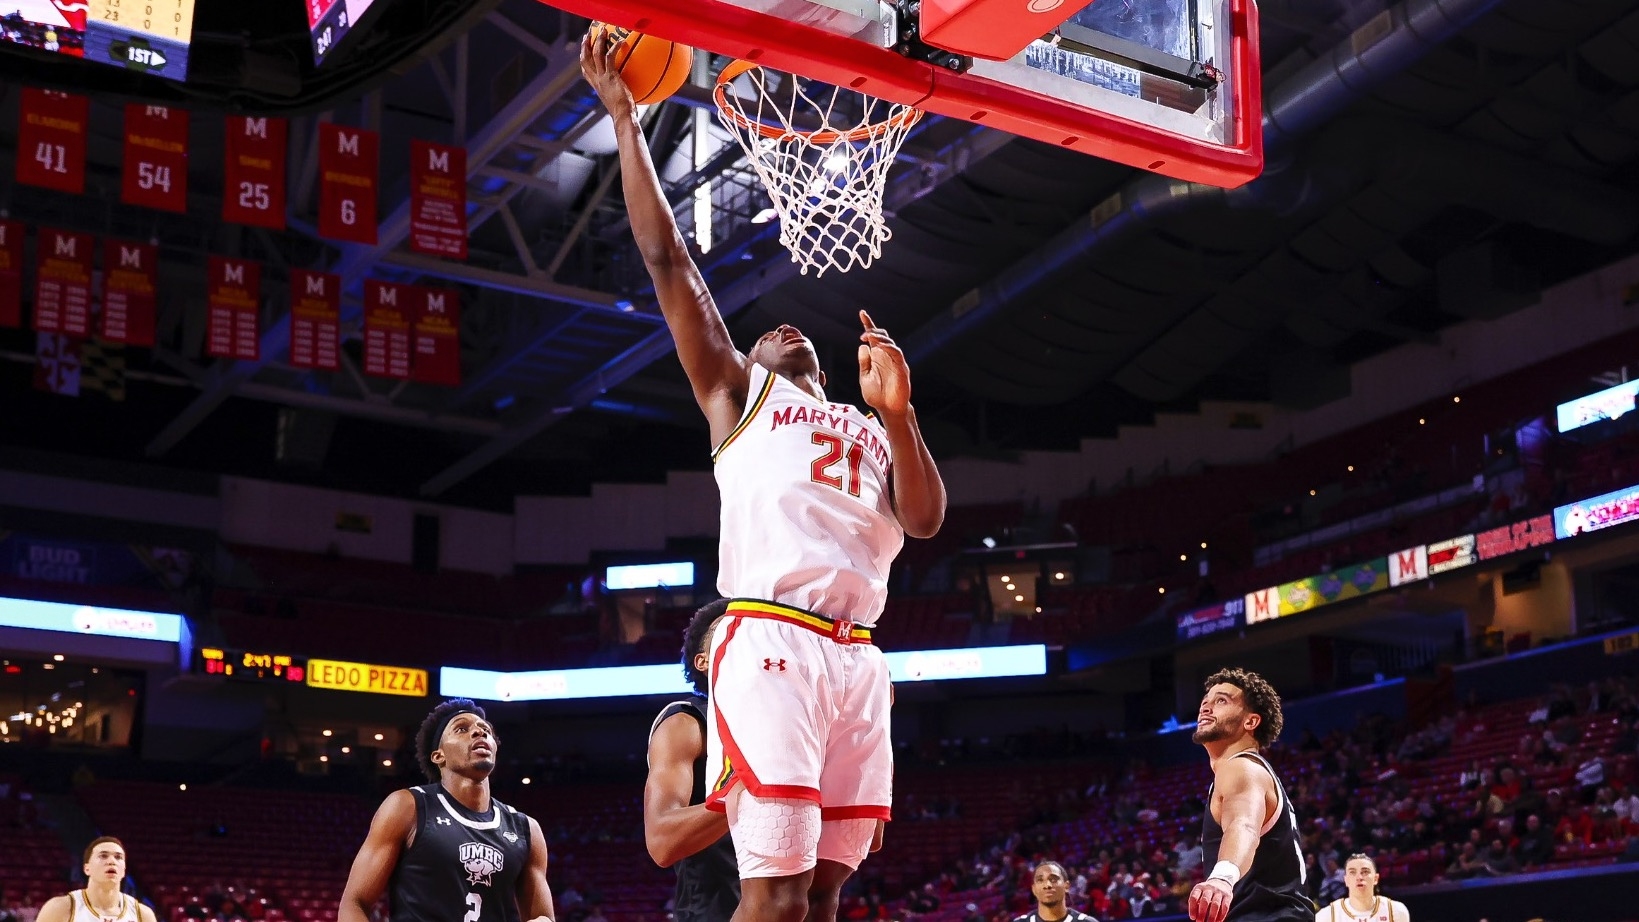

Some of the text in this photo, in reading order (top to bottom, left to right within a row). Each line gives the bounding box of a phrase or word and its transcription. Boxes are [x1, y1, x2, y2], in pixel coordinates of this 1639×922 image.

[128, 46, 152, 65] 1ST
[245, 116, 267, 139] M
[337, 130, 360, 157] M
[34, 141, 68, 174] 41
[428, 148, 449, 173] M
[137, 161, 171, 193] 54
[239, 181, 270, 210] 25
[340, 198, 356, 225] 6
[54, 233, 77, 258] M
[119, 245, 141, 268] M
[224, 262, 245, 285] M
[305, 274, 325, 297] M
[379, 285, 397, 307] M
[427, 292, 445, 313] M
[770, 405, 891, 477] MARYLAND
[811, 431, 864, 498] 21
[29, 545, 81, 564] BUD
[1397, 547, 1417, 578] M
[18, 561, 90, 584] LIGHT
[1254, 591, 1270, 618] M
[836, 620, 852, 641] M
[309, 663, 361, 687] LEDO
[368, 668, 425, 693] PIZZA
[459, 842, 504, 871] UMBC
